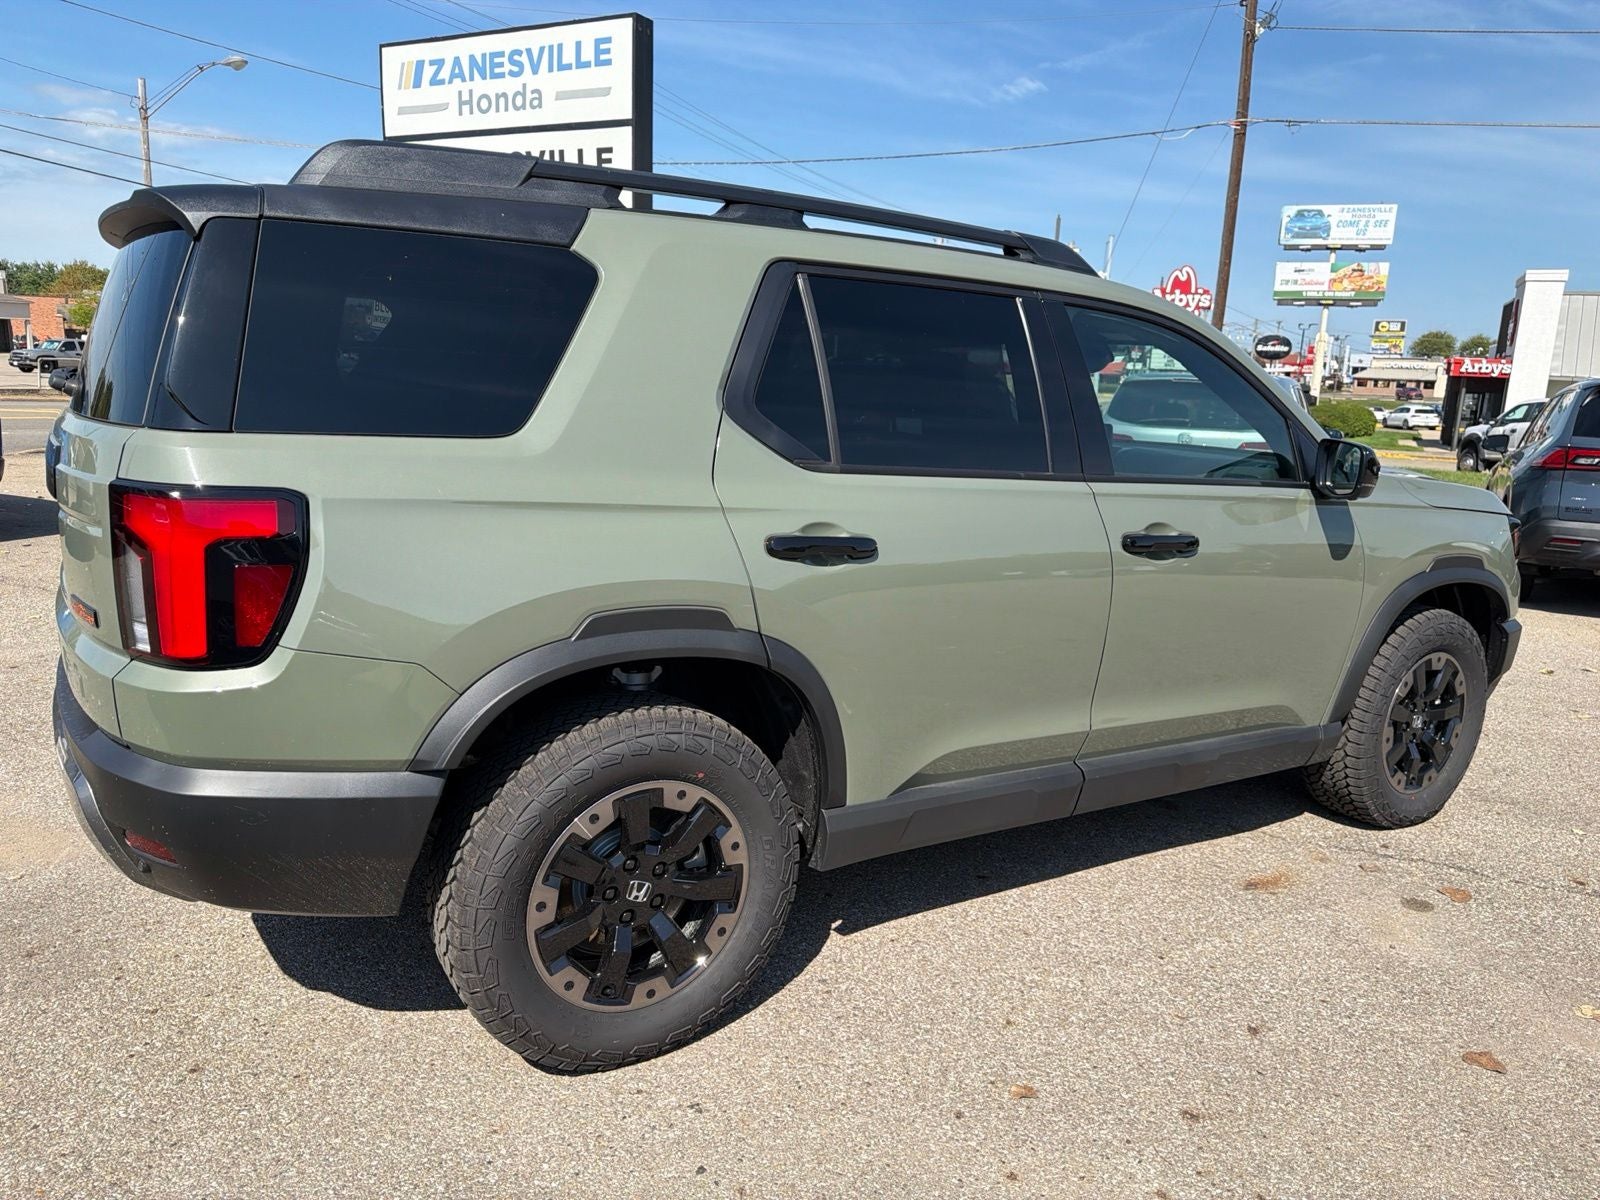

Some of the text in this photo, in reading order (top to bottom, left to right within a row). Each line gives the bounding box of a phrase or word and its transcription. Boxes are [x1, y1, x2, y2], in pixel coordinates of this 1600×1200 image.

[428, 36, 612, 87] ZANESVILLE
[457, 83, 543, 116] Honda
[1336, 219, 1390, 228] COME & SEE
[1355, 228, 1368, 236] US
[1256, 344, 1289, 352] Safelite
[1460, 358, 1512, 376] Arby's
